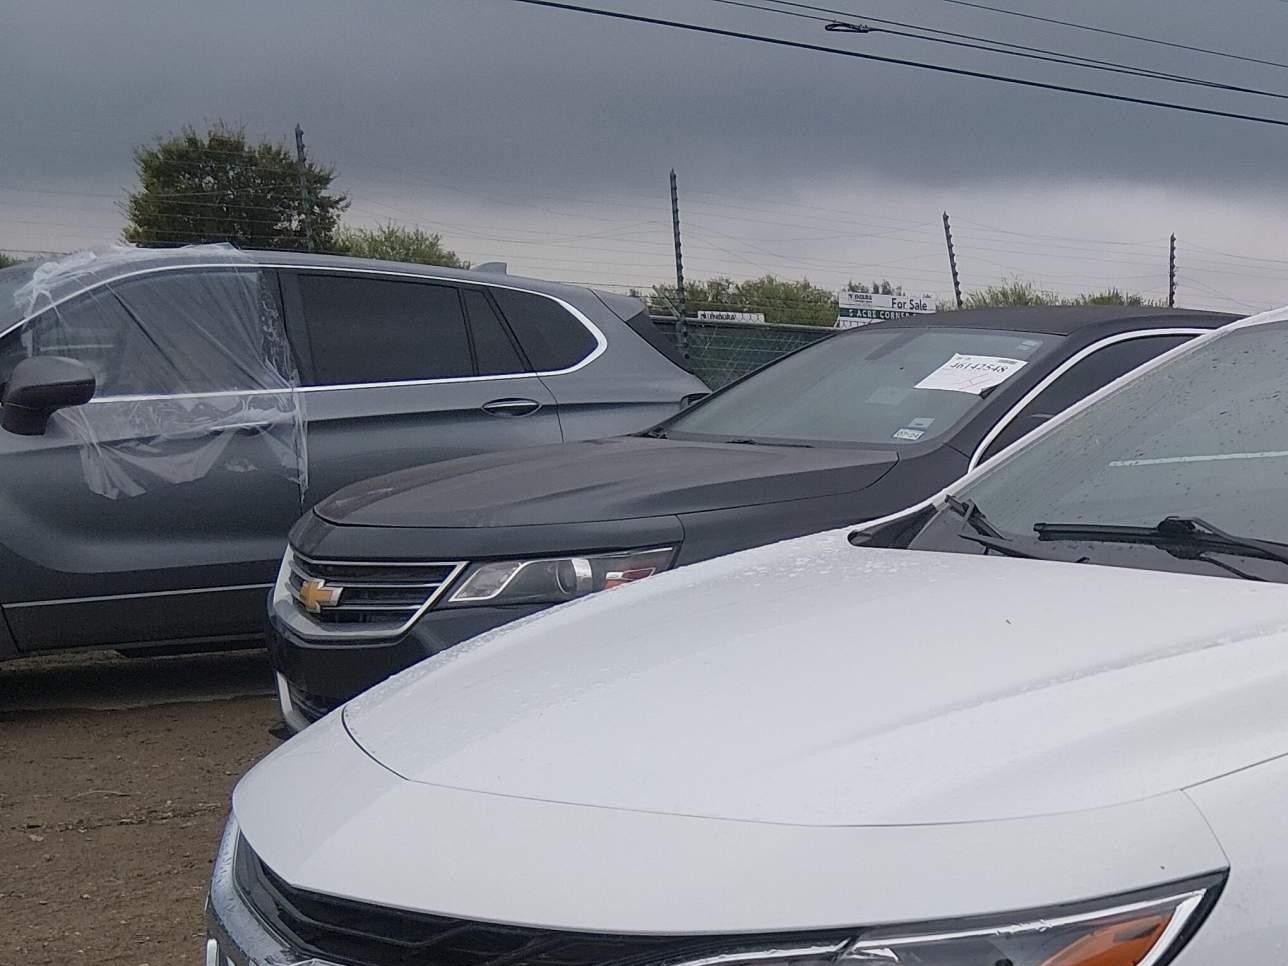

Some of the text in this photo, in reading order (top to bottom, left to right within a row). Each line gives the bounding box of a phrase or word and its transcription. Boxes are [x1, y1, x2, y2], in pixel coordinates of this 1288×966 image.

[891, 297, 928, 311] For Sale
[856, 309, 877, 318] ACRE
